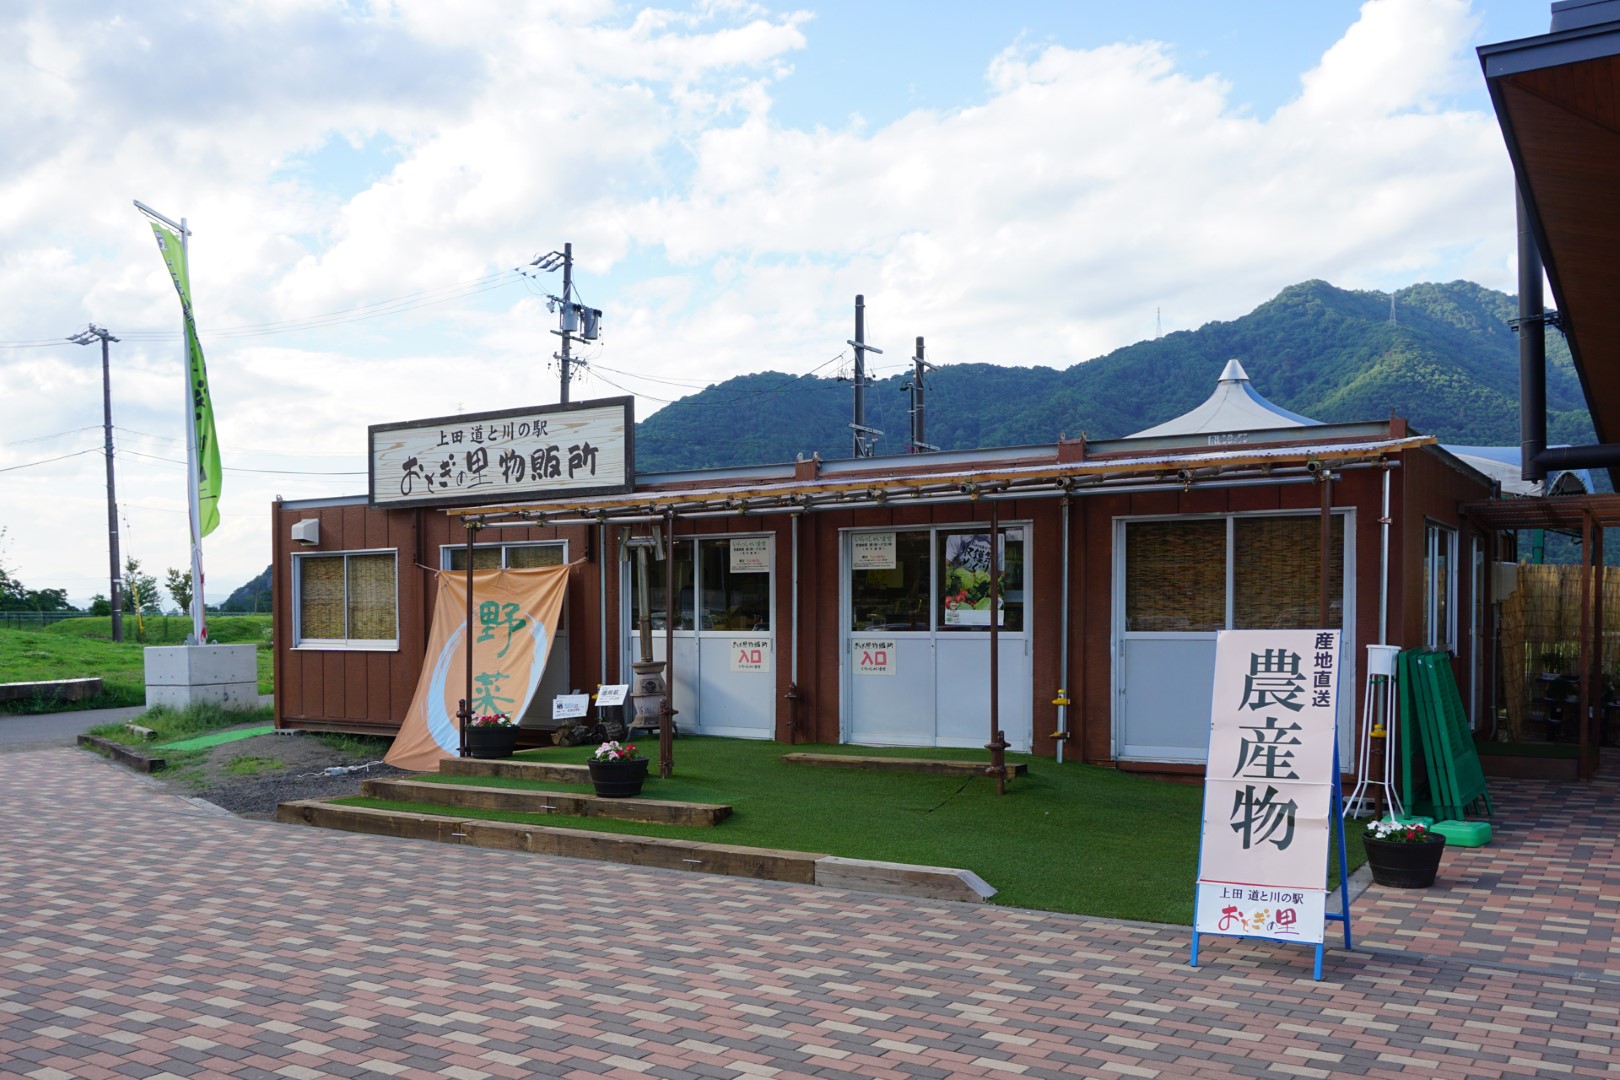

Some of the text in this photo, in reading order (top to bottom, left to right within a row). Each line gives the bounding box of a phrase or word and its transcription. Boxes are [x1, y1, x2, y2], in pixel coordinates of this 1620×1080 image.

[436, 419, 549, 448] 上田 道と川の駅
[472, 600, 527, 715] 野菜
[738, 649, 762, 664] 入口
[860, 650, 887, 666] 入口
[1312, 631, 1335, 708] 産地直送
[1230, 647, 1307, 851] 農産物
[1219, 886, 1305, 905] 上田 道と川の駅
[1218, 904, 1301, 936] おとぎの里
